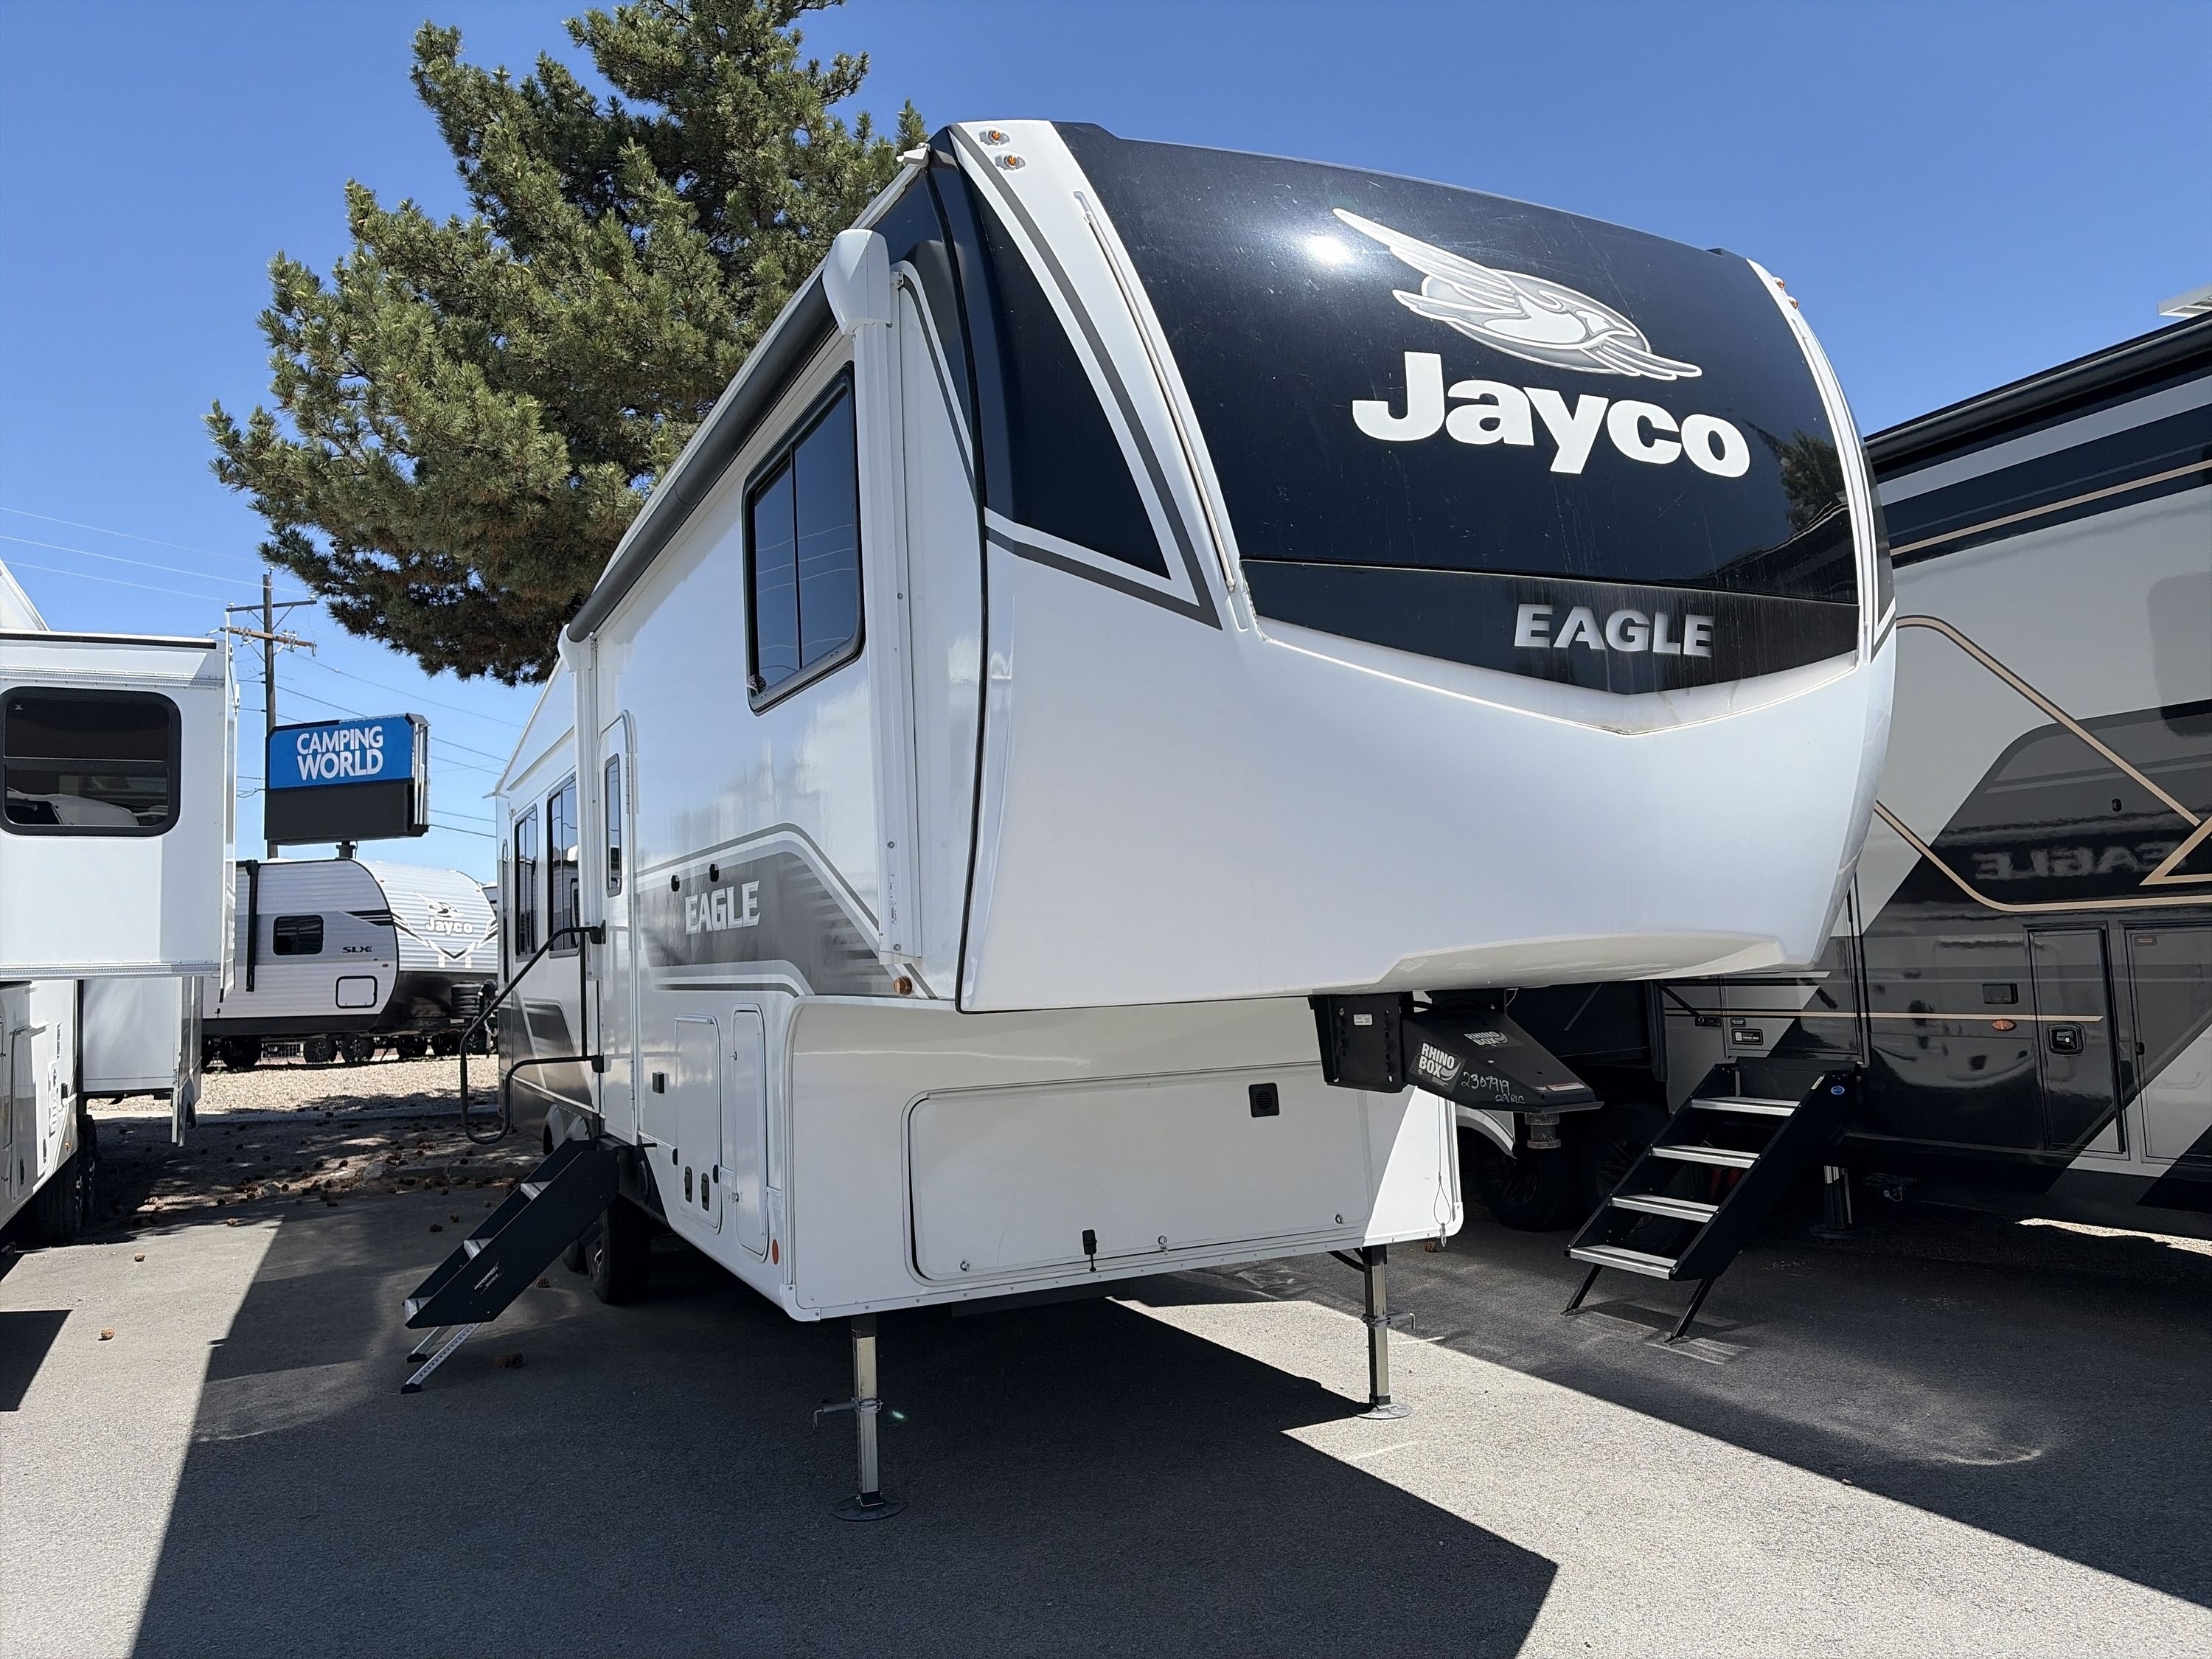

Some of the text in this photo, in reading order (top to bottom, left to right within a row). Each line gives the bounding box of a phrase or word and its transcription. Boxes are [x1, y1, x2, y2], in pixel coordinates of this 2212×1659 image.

[1352, 351, 1750, 478] Jayco
[1514, 603, 1714, 658] EAGLE
[296, 726, 383, 755] CAMPING
[296, 748, 383, 780] WORLD
[685, 880, 761, 934] EAGLE
[425, 915, 473, 936] Jayco
[1421, 1042, 1455, 1069] RHINO
[1472, 1037, 1501, 1046] BOX
[1419, 1055, 1443, 1078] BOX
